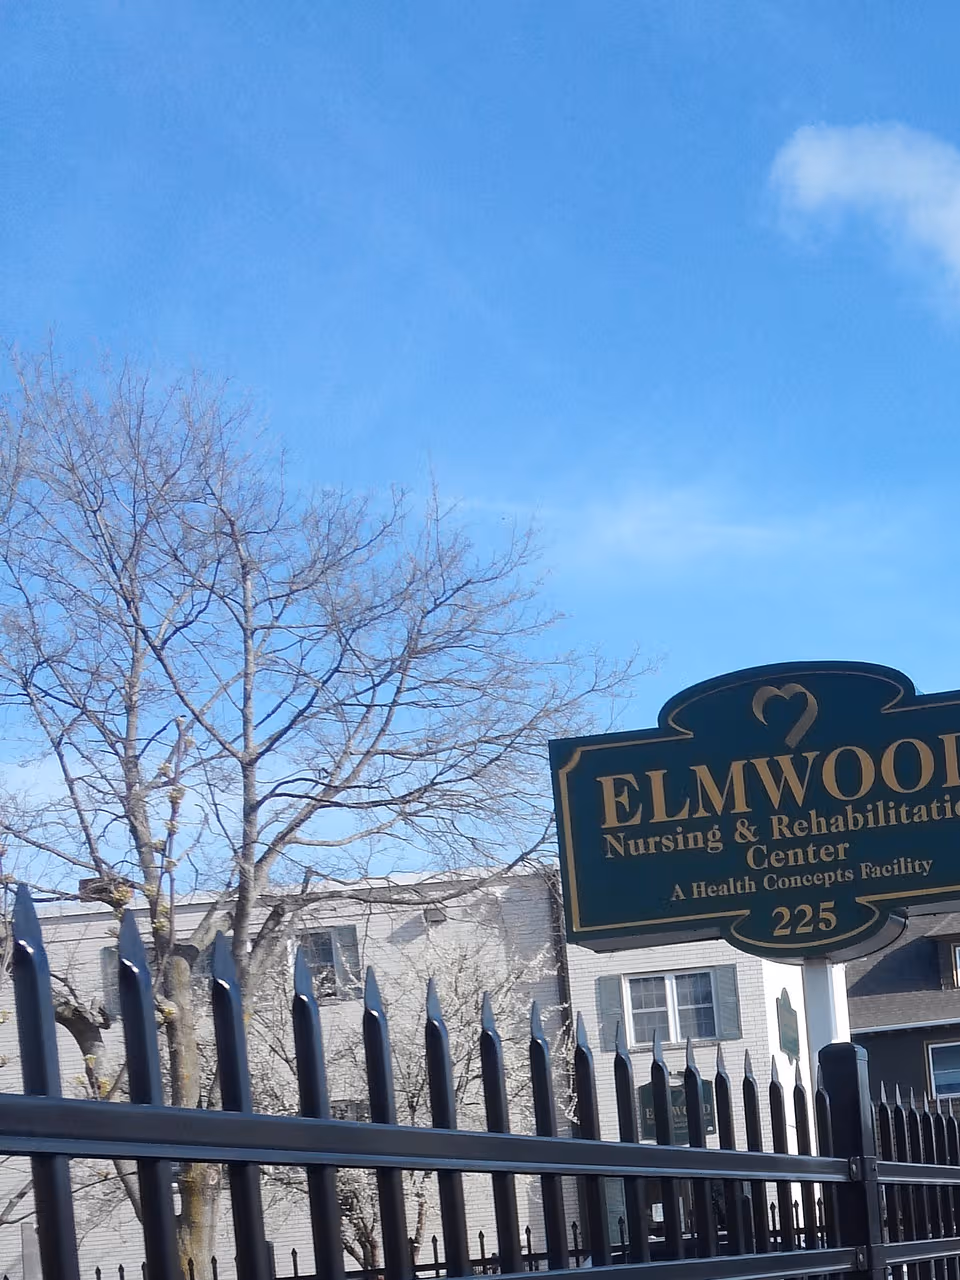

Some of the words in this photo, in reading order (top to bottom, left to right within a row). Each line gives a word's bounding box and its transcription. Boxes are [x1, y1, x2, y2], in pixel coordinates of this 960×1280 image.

[603, 824, 723, 858] Nursing
[735, 819, 759, 843] &
[746, 841, 850, 870] Center
[671, 882, 686, 901] A
[692, 875, 756, 899] Health
[762, 869, 854, 892] Concepts
[861, 857, 933, 881] Facility
[772, 901, 838, 936] 225
